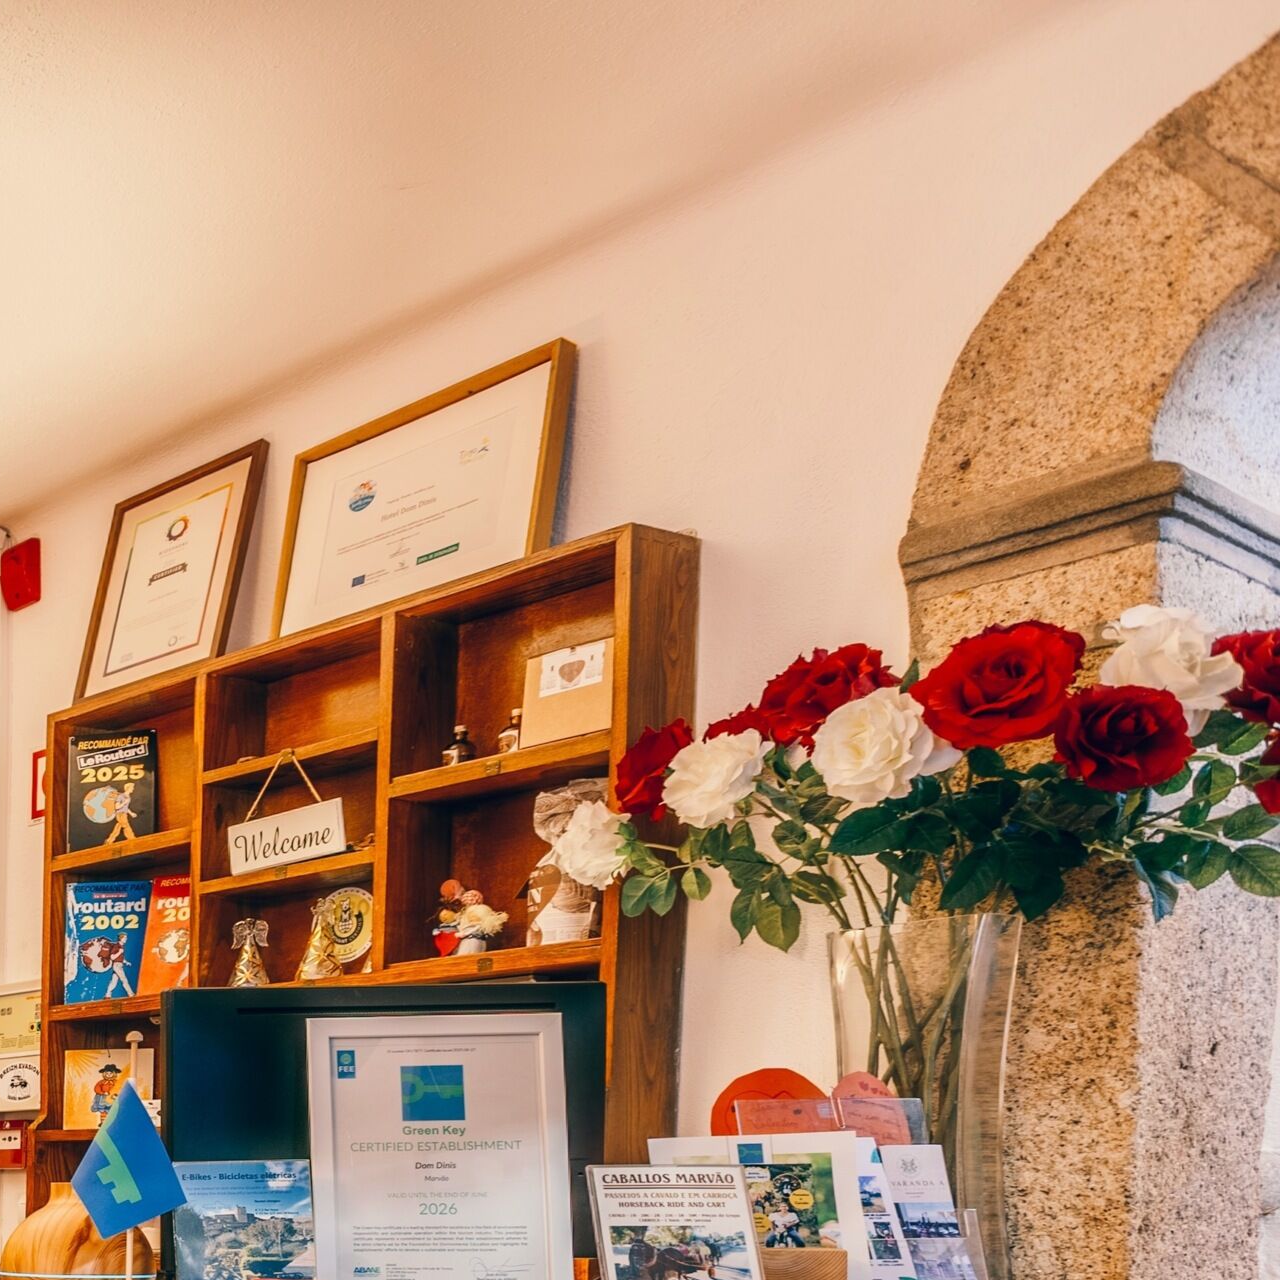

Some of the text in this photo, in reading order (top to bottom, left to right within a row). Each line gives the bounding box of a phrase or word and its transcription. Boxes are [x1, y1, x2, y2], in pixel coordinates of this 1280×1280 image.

[78, 736, 149, 751] RECOMMANDÉ PAR
[80, 746, 145, 768] Le Routard
[80, 764, 145, 783] 2025
[234, 826, 333, 862] Welcome
[74, 898, 146, 914] routard
[80, 914, 139, 930] 2002
[338, 1065, 355, 1073] FEE
[402, 1125, 466, 1137] Green Key
[350, 1139, 522, 1152] CERTIFIED ESTABLISHMENT
[414, 1161, 457, 1170] Dom Dinis
[181, 1173, 212, 1181] E-Bikes
[218, 1172, 258, 1181] Bicicletas
[260, 1171, 297, 1180] elétricas
[602, 1173, 671, 1184] CABALLOS
[675, 1172, 735, 1184] MARVÃO
[702, 1192, 738, 1200] CARROÇA
[418, 1203, 458, 1215] 2026
